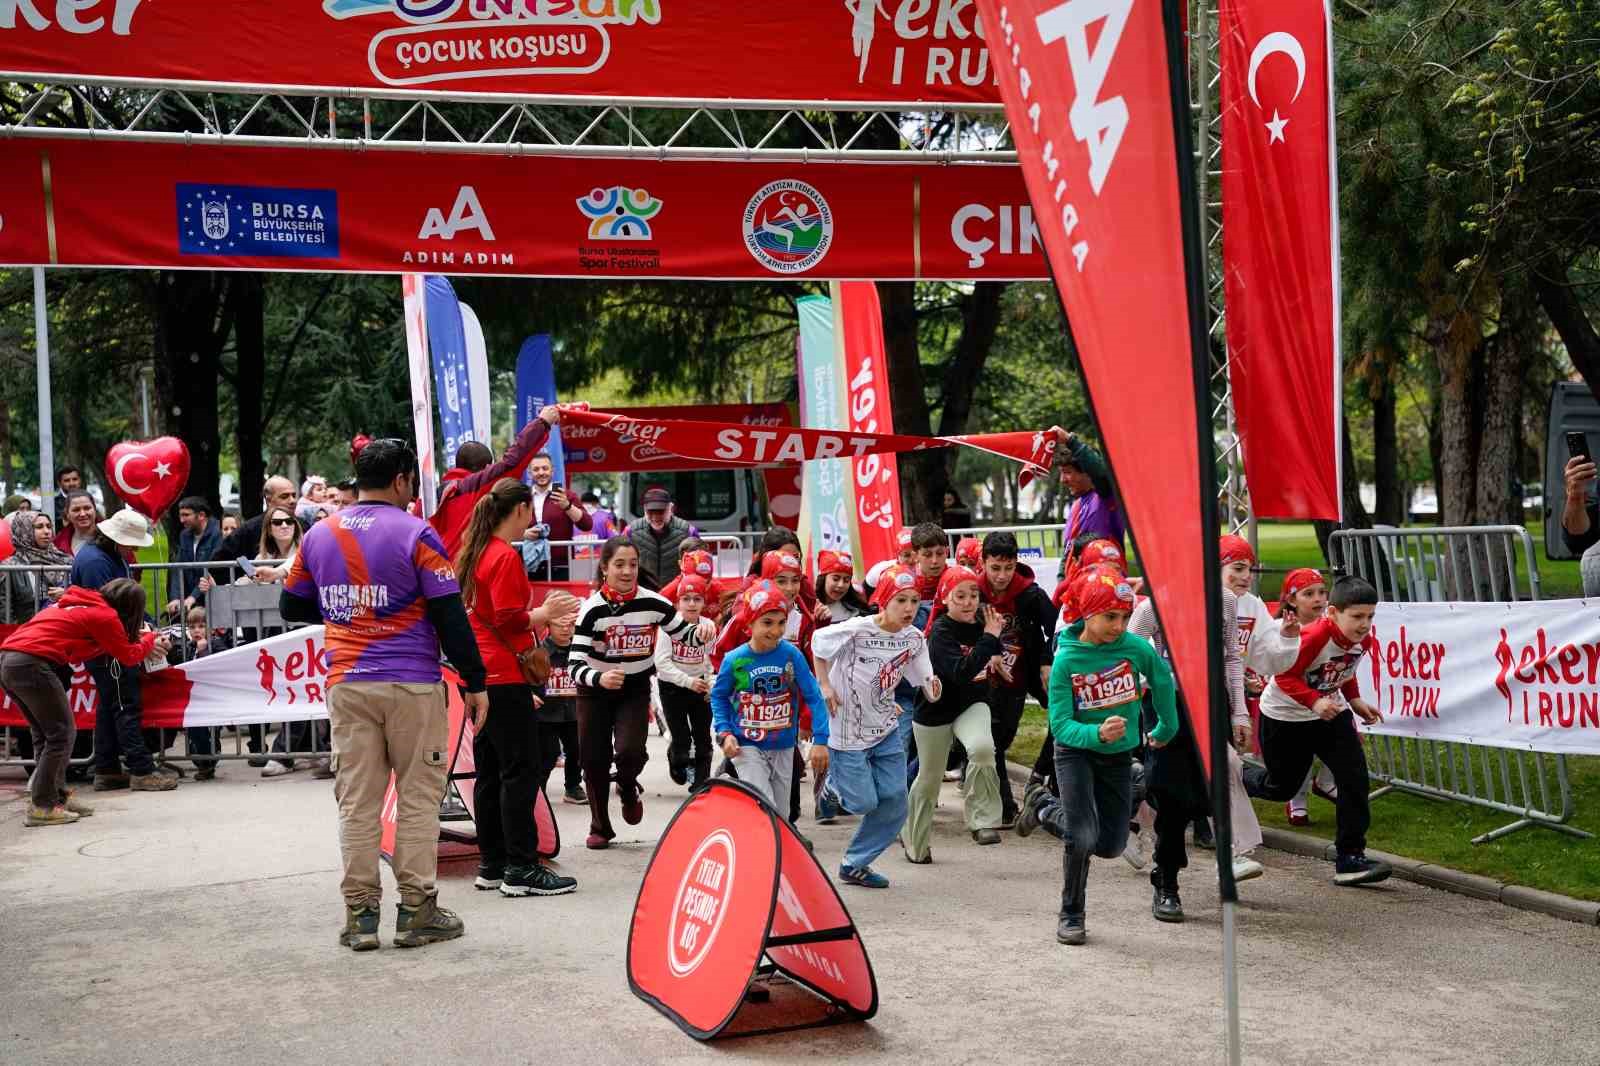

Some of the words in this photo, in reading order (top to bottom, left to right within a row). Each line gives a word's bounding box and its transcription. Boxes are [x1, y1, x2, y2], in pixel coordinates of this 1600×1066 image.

[396, 38, 485, 68] ÇOCUK
[490, 33, 587, 62] KOŞUSU
[892, 47, 905, 85] I
[926, 47, 999, 85] RU
[252, 202, 324, 220] BURSA
[762, 182, 793, 198] ATLETİZM
[795, 182, 831, 225] FEDERASYONU
[253, 217, 324, 232] BÜYÜKŞEHİR
[254, 230, 325, 244] BELEDİYESİ
[402, 251, 454, 265] ADIM
[463, 252, 514, 265] ADIM
[580, 257, 608, 269] Spor
[610, 256, 661, 269] Festivali
[766, 257, 797, 270] ATHLETIC
[798, 234, 829, 268] FEDERATION
[714, 429, 876, 462] START
[623, 634, 651, 649] 1920
[1387, 625, 1446, 681] eker
[1514, 627, 1600, 685] eker
[749, 665, 783, 678] AVENGERS
[1094, 672, 1135, 698] 1920
[757, 702, 791, 720] 1920
[1389, 684, 1395, 715] I
[1401, 685, 1440, 719] RUN
[1522, 690, 1529, 725] I
[1538, 691, 1600, 729] RUN
[679, 921, 700, 956] KOŞ
